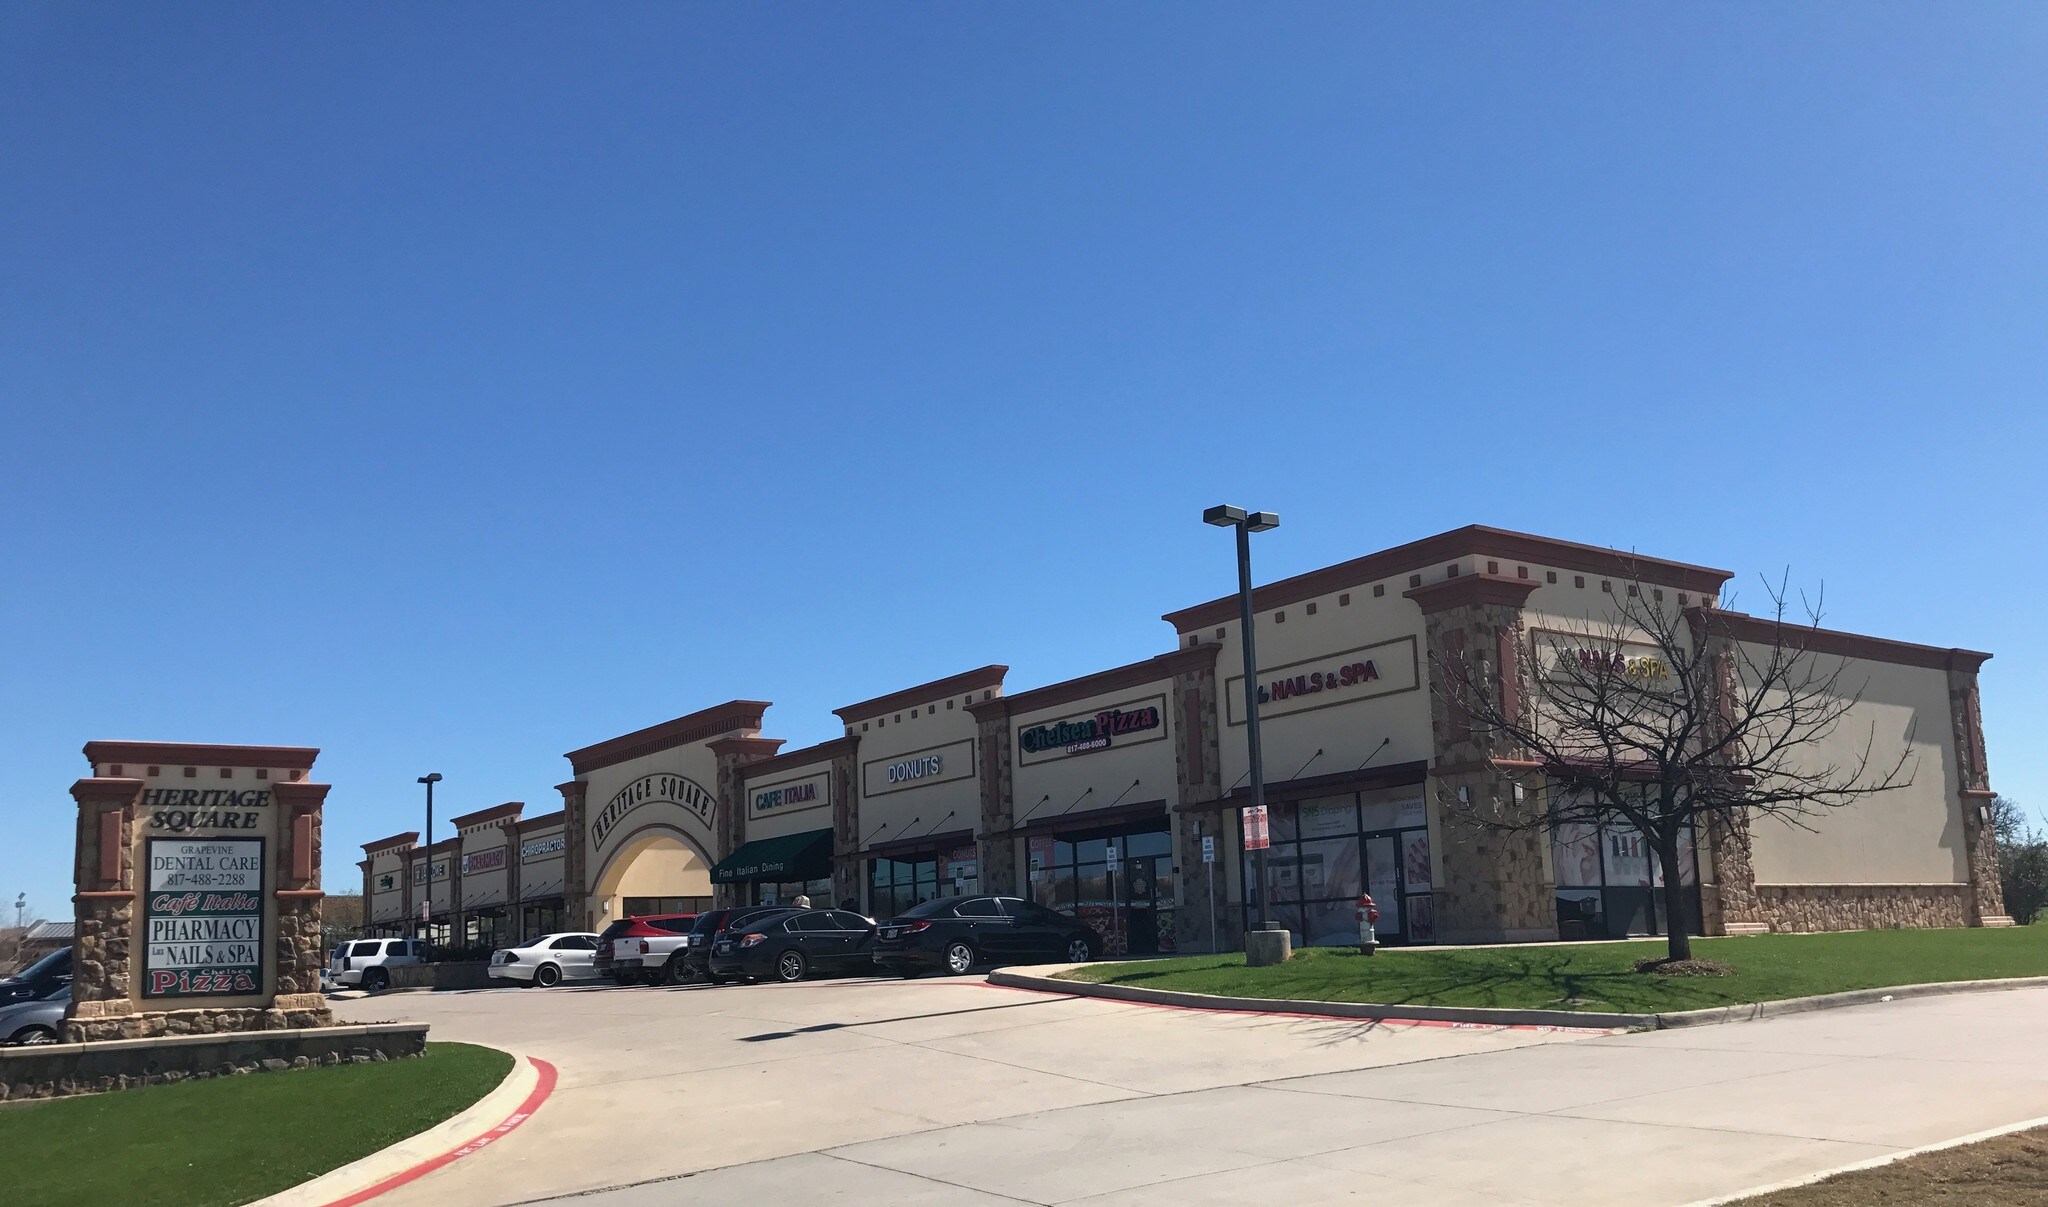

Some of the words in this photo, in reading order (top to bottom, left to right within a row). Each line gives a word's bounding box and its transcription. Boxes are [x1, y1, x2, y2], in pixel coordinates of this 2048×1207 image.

[1628, 658, 1638, 676] &
[1640, 657, 1669, 681] SPA
[1271, 672, 1323, 701] NAILS
[1326, 673, 1338, 689] &
[1340, 660, 1379, 687] SPA
[1021, 720, 1092, 750] Chelsea
[1095, 708, 1154, 736] Pizza
[888, 755, 940, 783] DONUTS
[139, 788, 271, 807] HERITAGE
[756, 789, 782, 811] CAFE
[784, 783, 817, 804] ITALIA
[1401, 801, 1423, 811] SAVES
[596, 778, 651, 840] HERITAGE
[660, 777, 709, 817] SQUARE
[150, 811, 260, 832] SQUARE
[181, 845, 234, 855] GRAPEVINE
[522, 838, 566, 857] CHIROPRACTOR
[153, 856, 215, 871] DENTAL
[219, 856, 260, 871] CARE
[719, 869, 733, 878] Fine
[736, 866, 758, 876] Italian
[762, 862, 784, 872] Dining
[167, 873, 246, 886] 817-488-2288
[152, 892, 201, 916] Café
[201, 892, 259, 911] Italia
[152, 918, 258, 942] PHARMACY
[166, 945, 214, 966] NAILS
[216, 950, 225, 964] &
[228, 944, 255, 964] SPA
[151, 970, 256, 994] Pizza
[201, 968, 253, 976] Chelsea
